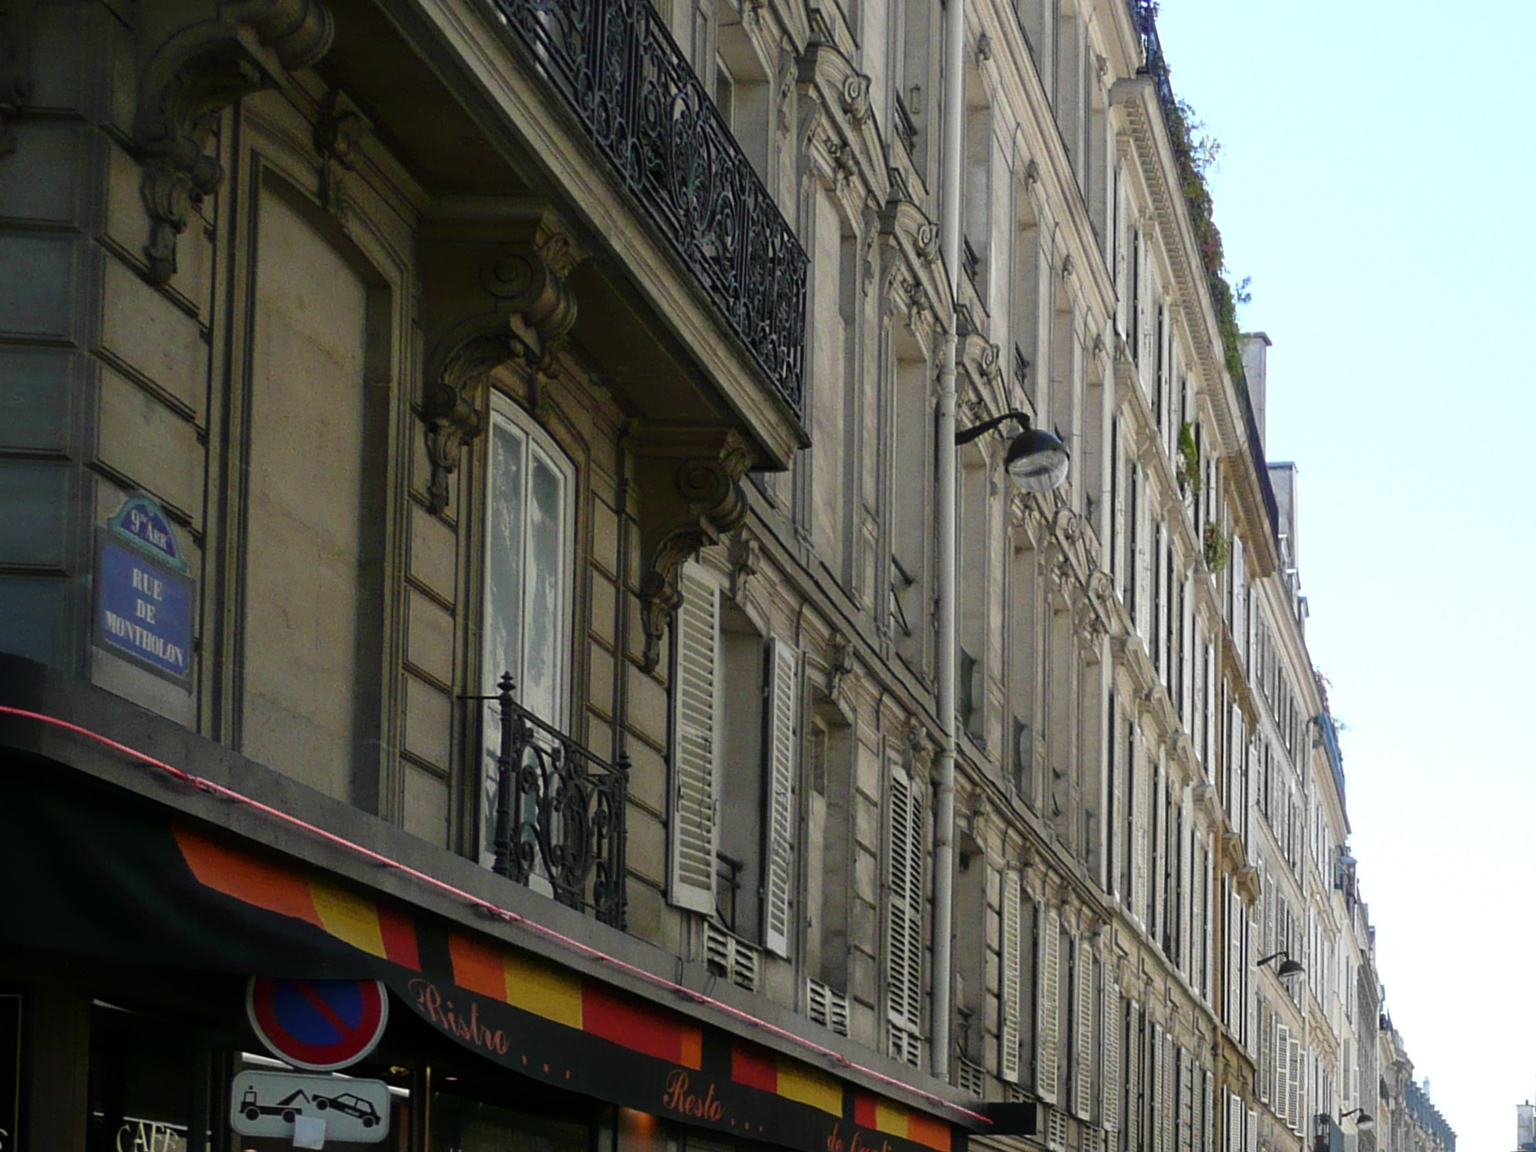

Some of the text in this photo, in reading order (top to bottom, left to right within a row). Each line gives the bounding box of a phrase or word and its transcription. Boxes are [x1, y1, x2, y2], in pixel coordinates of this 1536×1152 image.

[132, 567, 163, 602] RUE
[135, 598, 156, 625] DE
[105, 610, 184, 667] MONTHOLON
[663, 1070, 725, 1122] Resto
